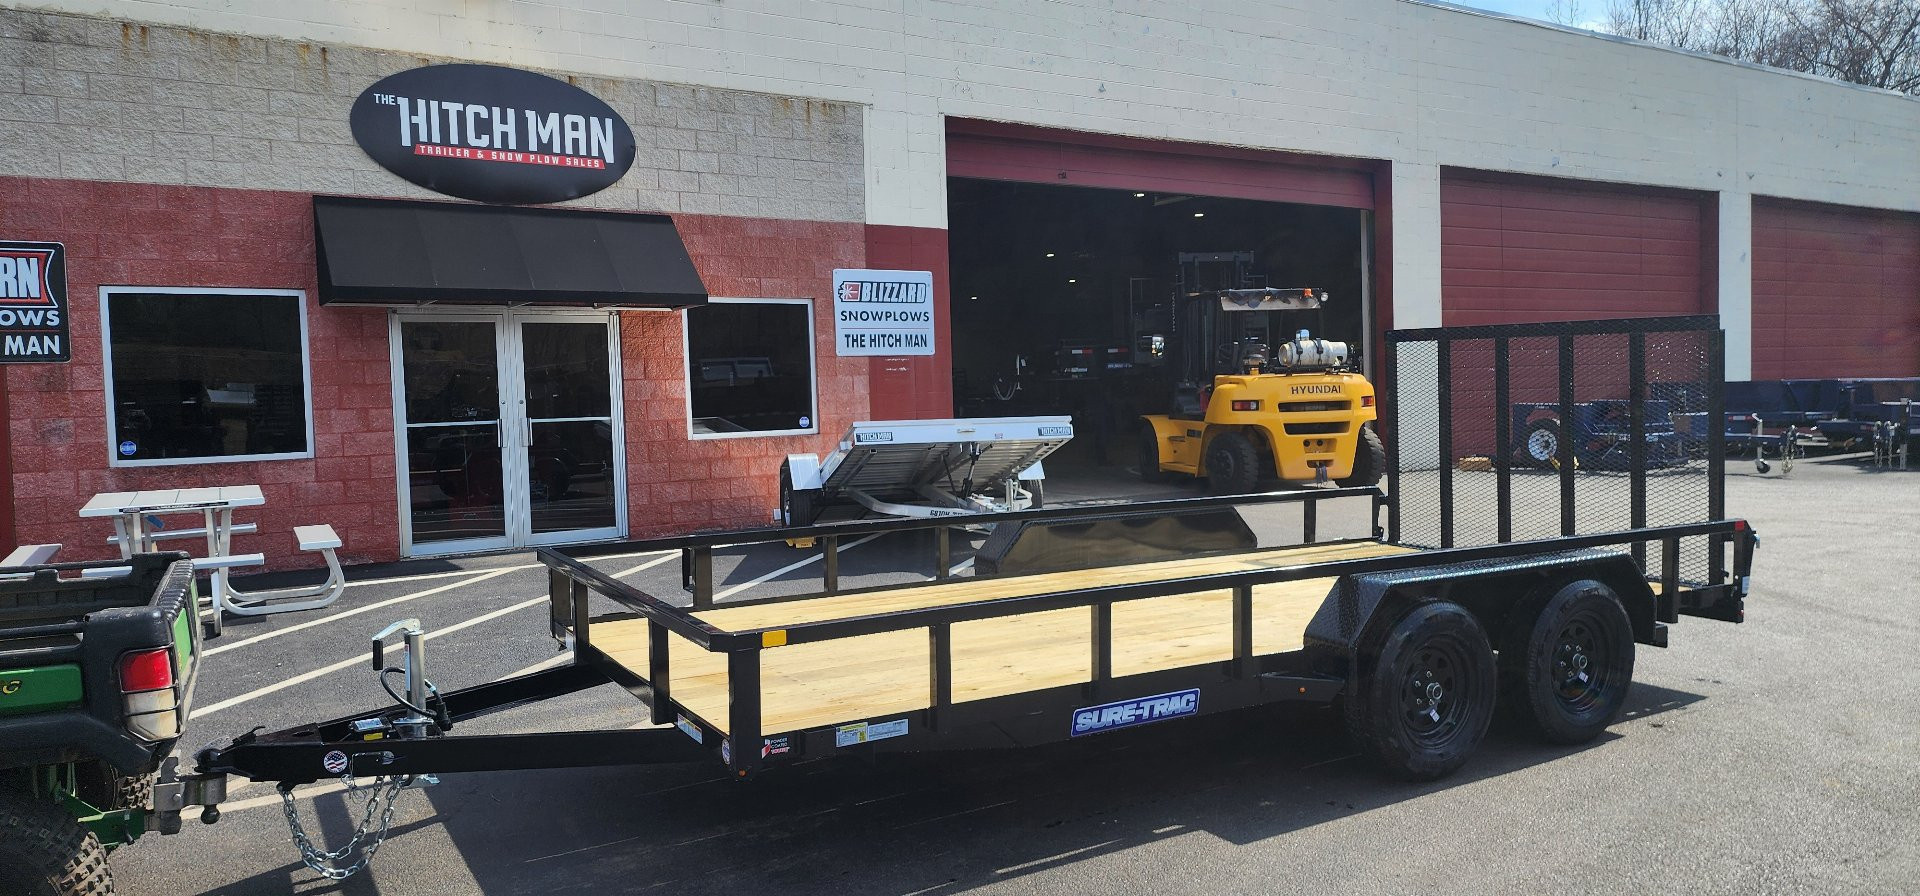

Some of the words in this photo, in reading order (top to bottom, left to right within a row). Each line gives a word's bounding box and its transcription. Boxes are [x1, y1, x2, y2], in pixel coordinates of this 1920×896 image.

[374, 93, 396, 106] THE
[397, 96, 516, 149] HITCH
[525, 109, 614, 163] MAN
[420, 145, 469, 158] TRAILER
[477, 150, 484, 159] &
[491, 150, 523, 162] SNOW
[530, 154, 559, 165] PLOW
[566, 157, 600, 167] SALES
[861, 283, 926, 302] BLIZZARD
[841, 310, 930, 321] SNOWPLOWS
[5, 335, 60, 355] MAN
[845, 334, 866, 348] THE
[869, 334, 901, 348] HITCH
[905, 334, 927, 348] MAN
[1291, 385, 1341, 394] HYUNDAI
[1076, 693, 1195, 732] SURE-TRAC
